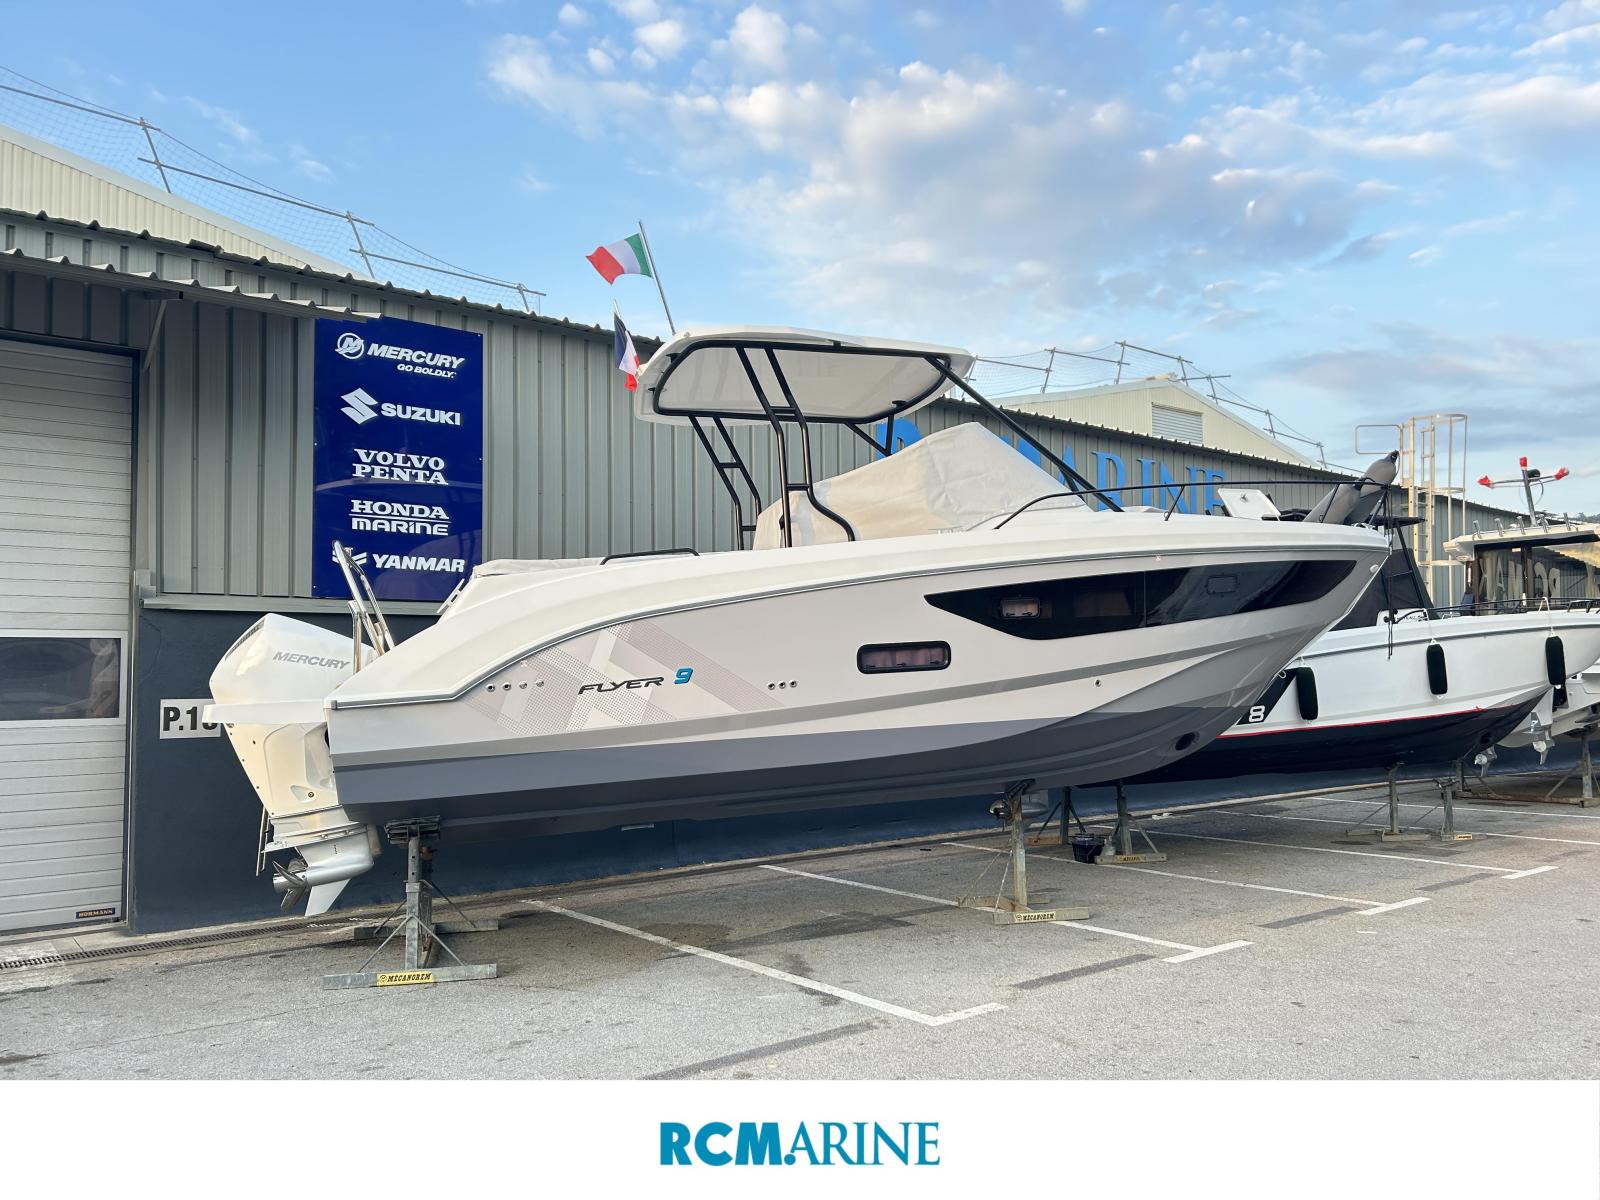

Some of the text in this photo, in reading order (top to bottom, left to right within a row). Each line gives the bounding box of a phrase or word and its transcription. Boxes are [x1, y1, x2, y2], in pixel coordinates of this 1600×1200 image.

[367, 343, 465, 369] MERCURY
[396, 363, 414, 372] GO
[380, 402, 461, 426] SUZUKI
[354, 448, 445, 471] VOLVO
[352, 463, 449, 485] PENTA
[351, 499, 450, 520] HONDA
[351, 517, 449, 536] MARINE
[372, 553, 466, 573] YANMAR
[273, 651, 351, 670] MERCURY
[578, 667, 694, 695] FLYER 9
[1249, 705, 1265, 723] 8
